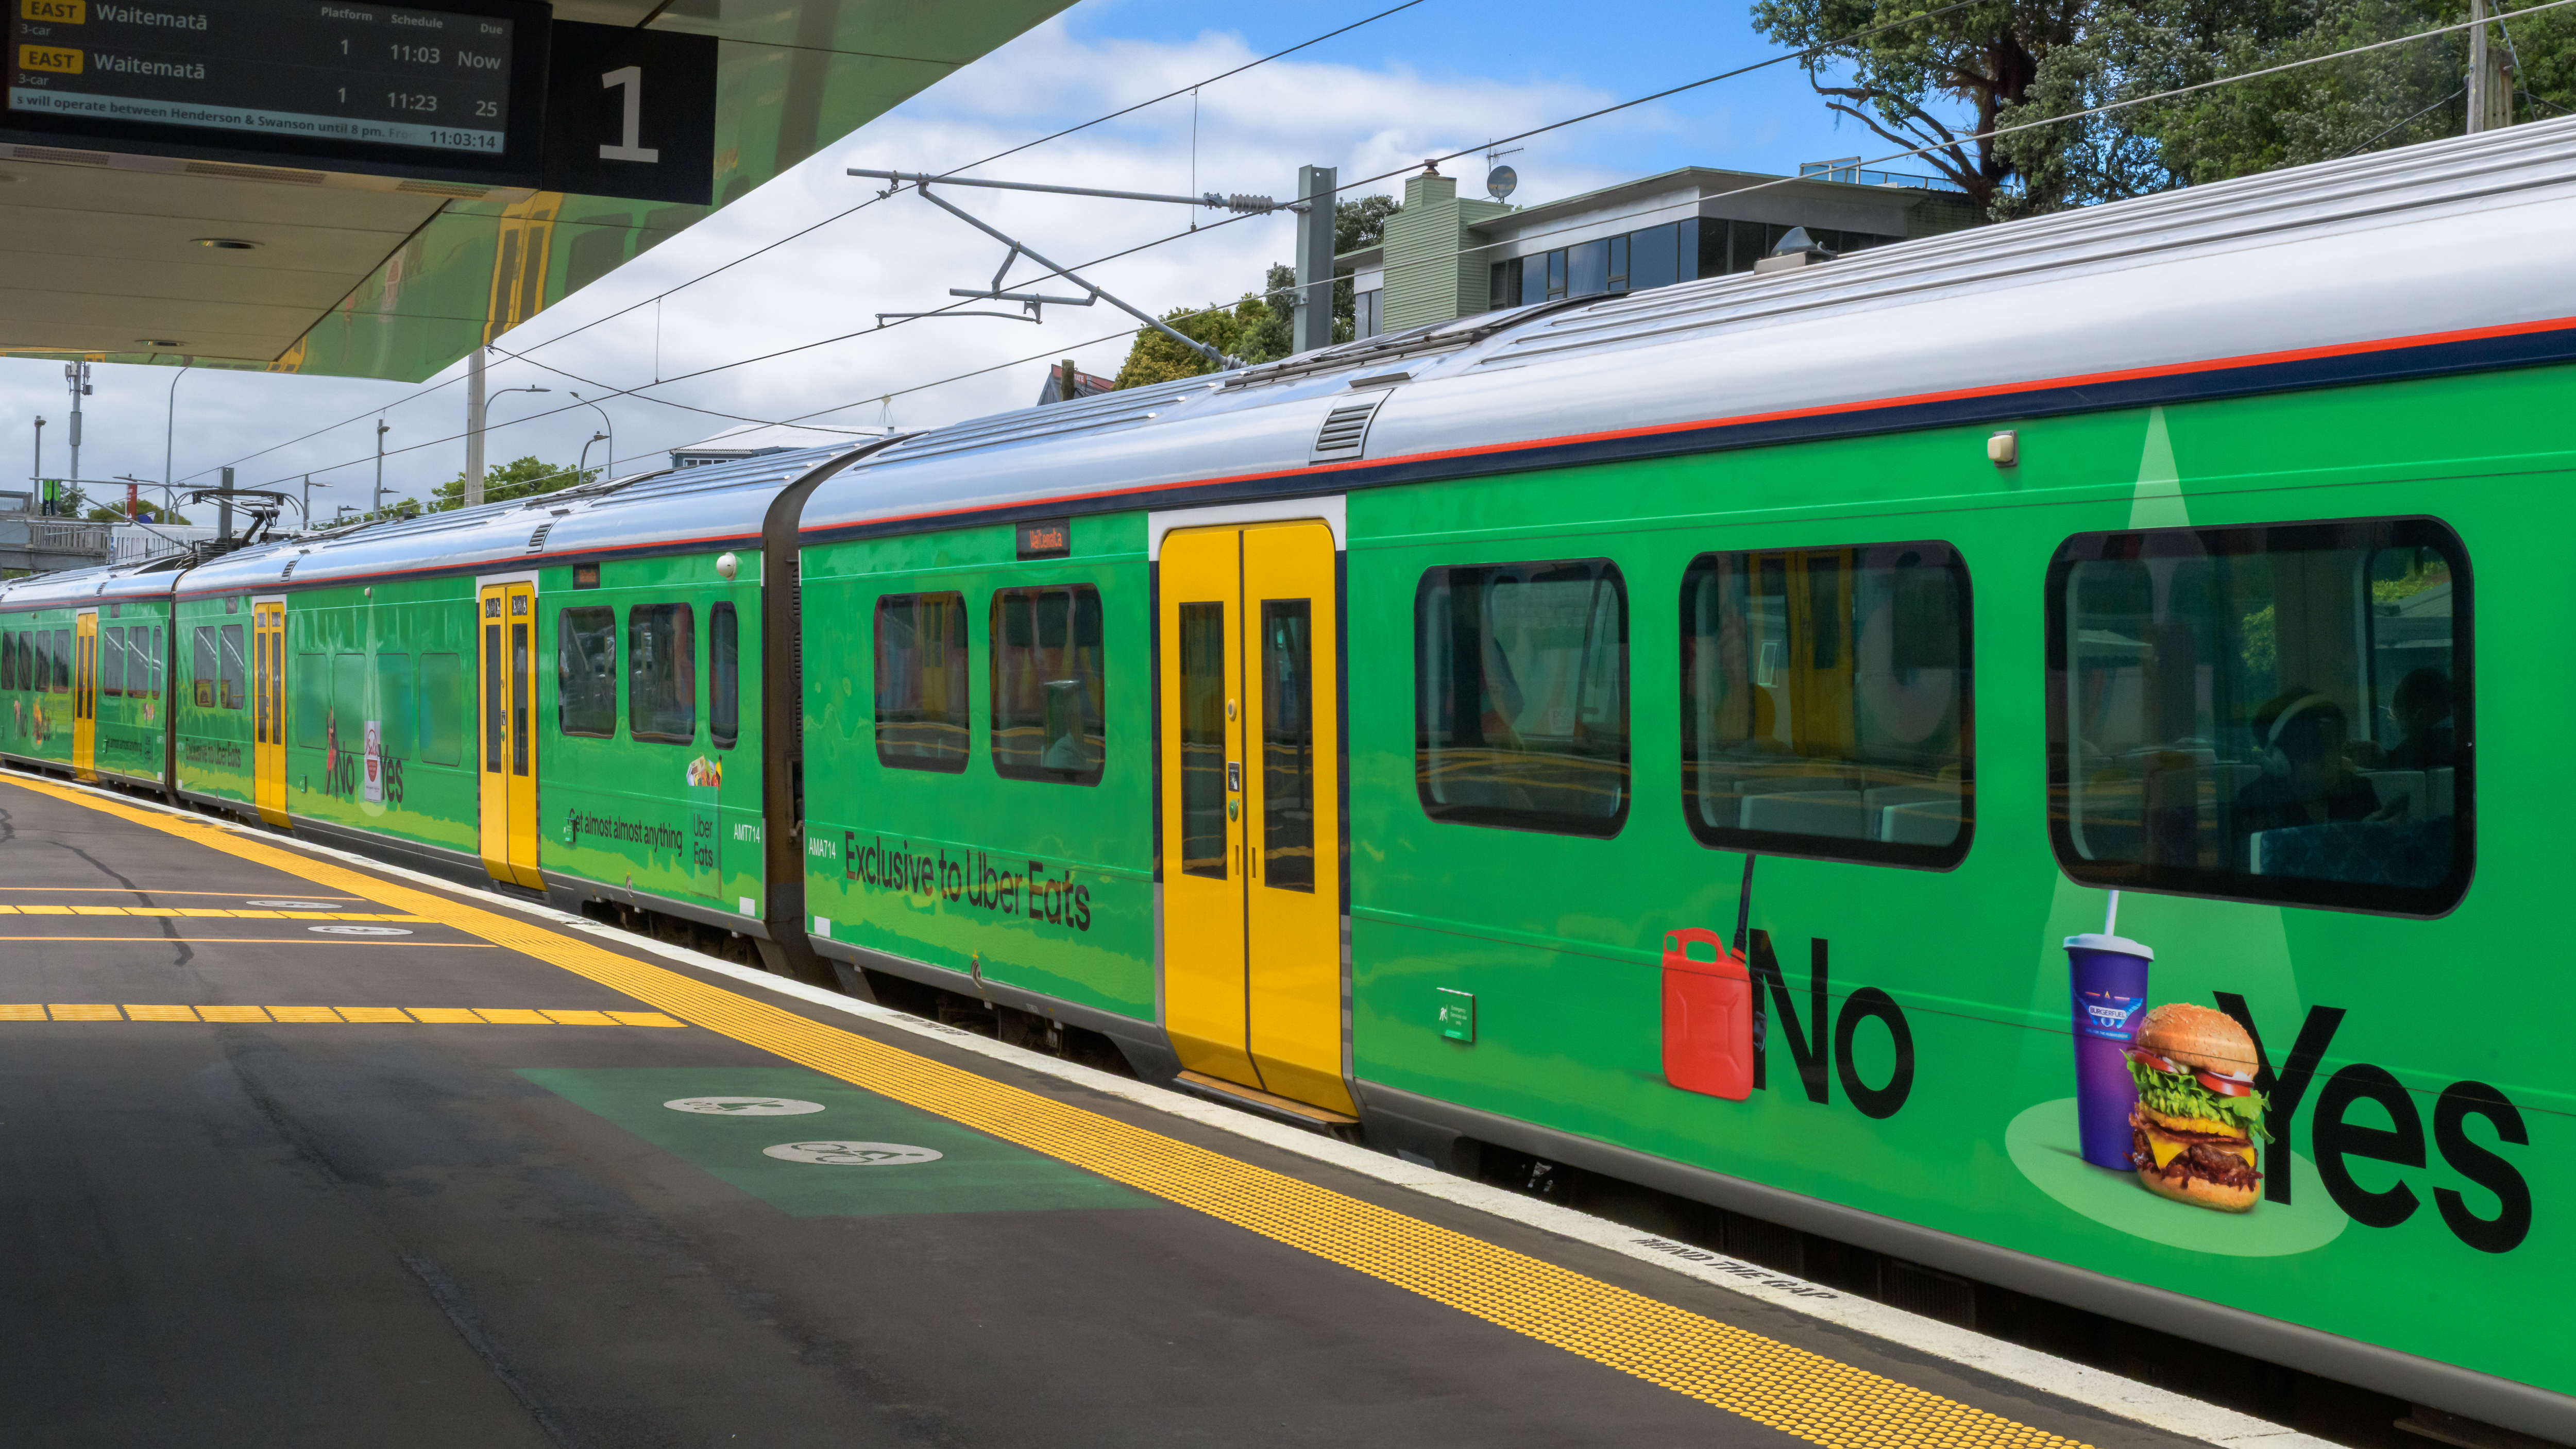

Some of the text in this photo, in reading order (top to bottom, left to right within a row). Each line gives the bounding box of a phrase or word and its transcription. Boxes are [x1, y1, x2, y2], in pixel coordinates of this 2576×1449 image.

[31, 1, 77, 19] EAST
[96, 4, 207, 30] Waitematā
[321, 7, 372, 21] Platform
[21, 24, 52, 36] 3-car
[391, 14, 443, 28] Schedule
[481, 24, 503, 34] Due
[341, 39, 349, 55] 1
[391, 44, 440, 64] 11:03
[29, 51, 75, 69] EAST
[94, 53, 205, 79] Waitematā
[458, 51, 501, 70] Now
[19, 74, 49, 85] 3-car
[338, 88, 346, 103] 1
[388, 92, 437, 111] 11:23
[27, 96, 50, 107] will
[55, 99, 106, 110] operate
[110, 100, 166, 117] between
[171, 108, 241, 124] Henderson
[245, 115, 254, 125] &
[258, 116, 314, 130] Swanson
[318, 119, 347, 133] until
[351, 125, 358, 134] 8
[476, 101, 497, 117] 25
[599, 65, 658, 163] 1
[430, 131, 496, 148] 11:03:14
[335, 740, 403, 804] No Yes
[585, 811, 612, 838] almost
[614, 816, 642, 843] almost
[644, 822, 683, 857] anything
[693, 813, 713, 838] Uber
[734, 823, 760, 843] AMT714
[694, 841, 713, 867] Eats
[808, 837, 836, 859] AMA714
[845, 830, 1091, 932] Exclusive to Uber Eats
[2090, 1007, 2125, 1018] BURGERFUEL
[1749, 928, 2532, 1253] No Yes
[1629, 1239, 1838, 1299] MIND THE GAP
